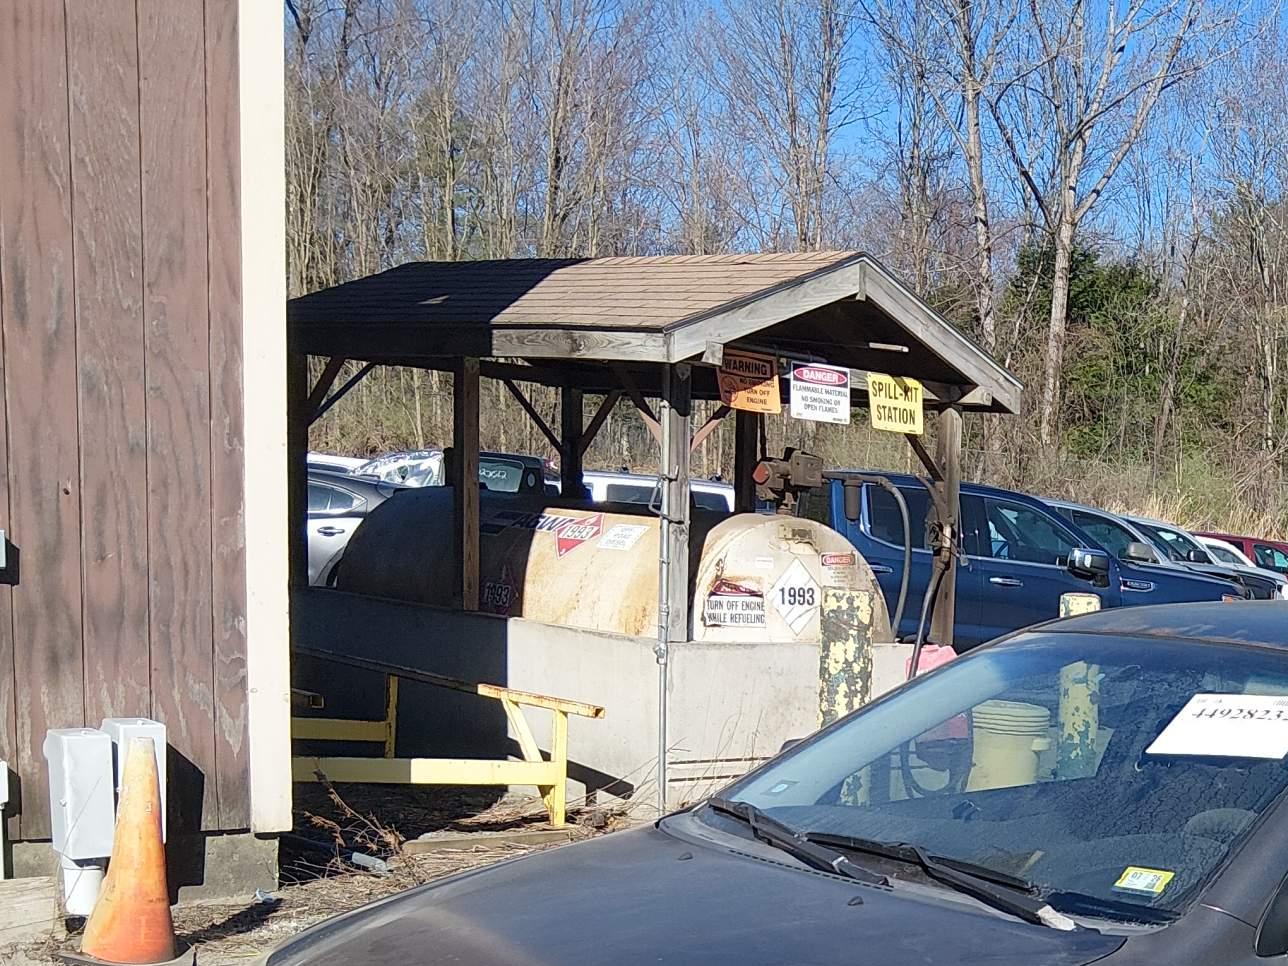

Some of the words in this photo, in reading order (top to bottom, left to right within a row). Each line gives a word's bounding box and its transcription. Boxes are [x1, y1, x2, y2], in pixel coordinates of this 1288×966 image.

[724, 359, 767, 375] WARNING
[803, 369, 839, 384] DANGER
[792, 384, 824, 395] FLAMMABLE
[871, 380, 919, 403] SPILL-KIT
[746, 396, 768, 405] ENGINE
[809, 396, 833, 405] SMOKING
[803, 403, 818, 411] OPEN
[818, 406, 838, 414] FLAMES
[876, 404, 916, 425] STATION
[564, 525, 594, 539] 1993
[778, 586, 815, 606] 1993
[707, 600, 723, 610] TURN
[726, 600, 739, 610] OFF
[741, 601, 765, 611] ENGINE
[707, 612, 728, 623] WHILE
[730, 613, 765, 624] REFUELING
